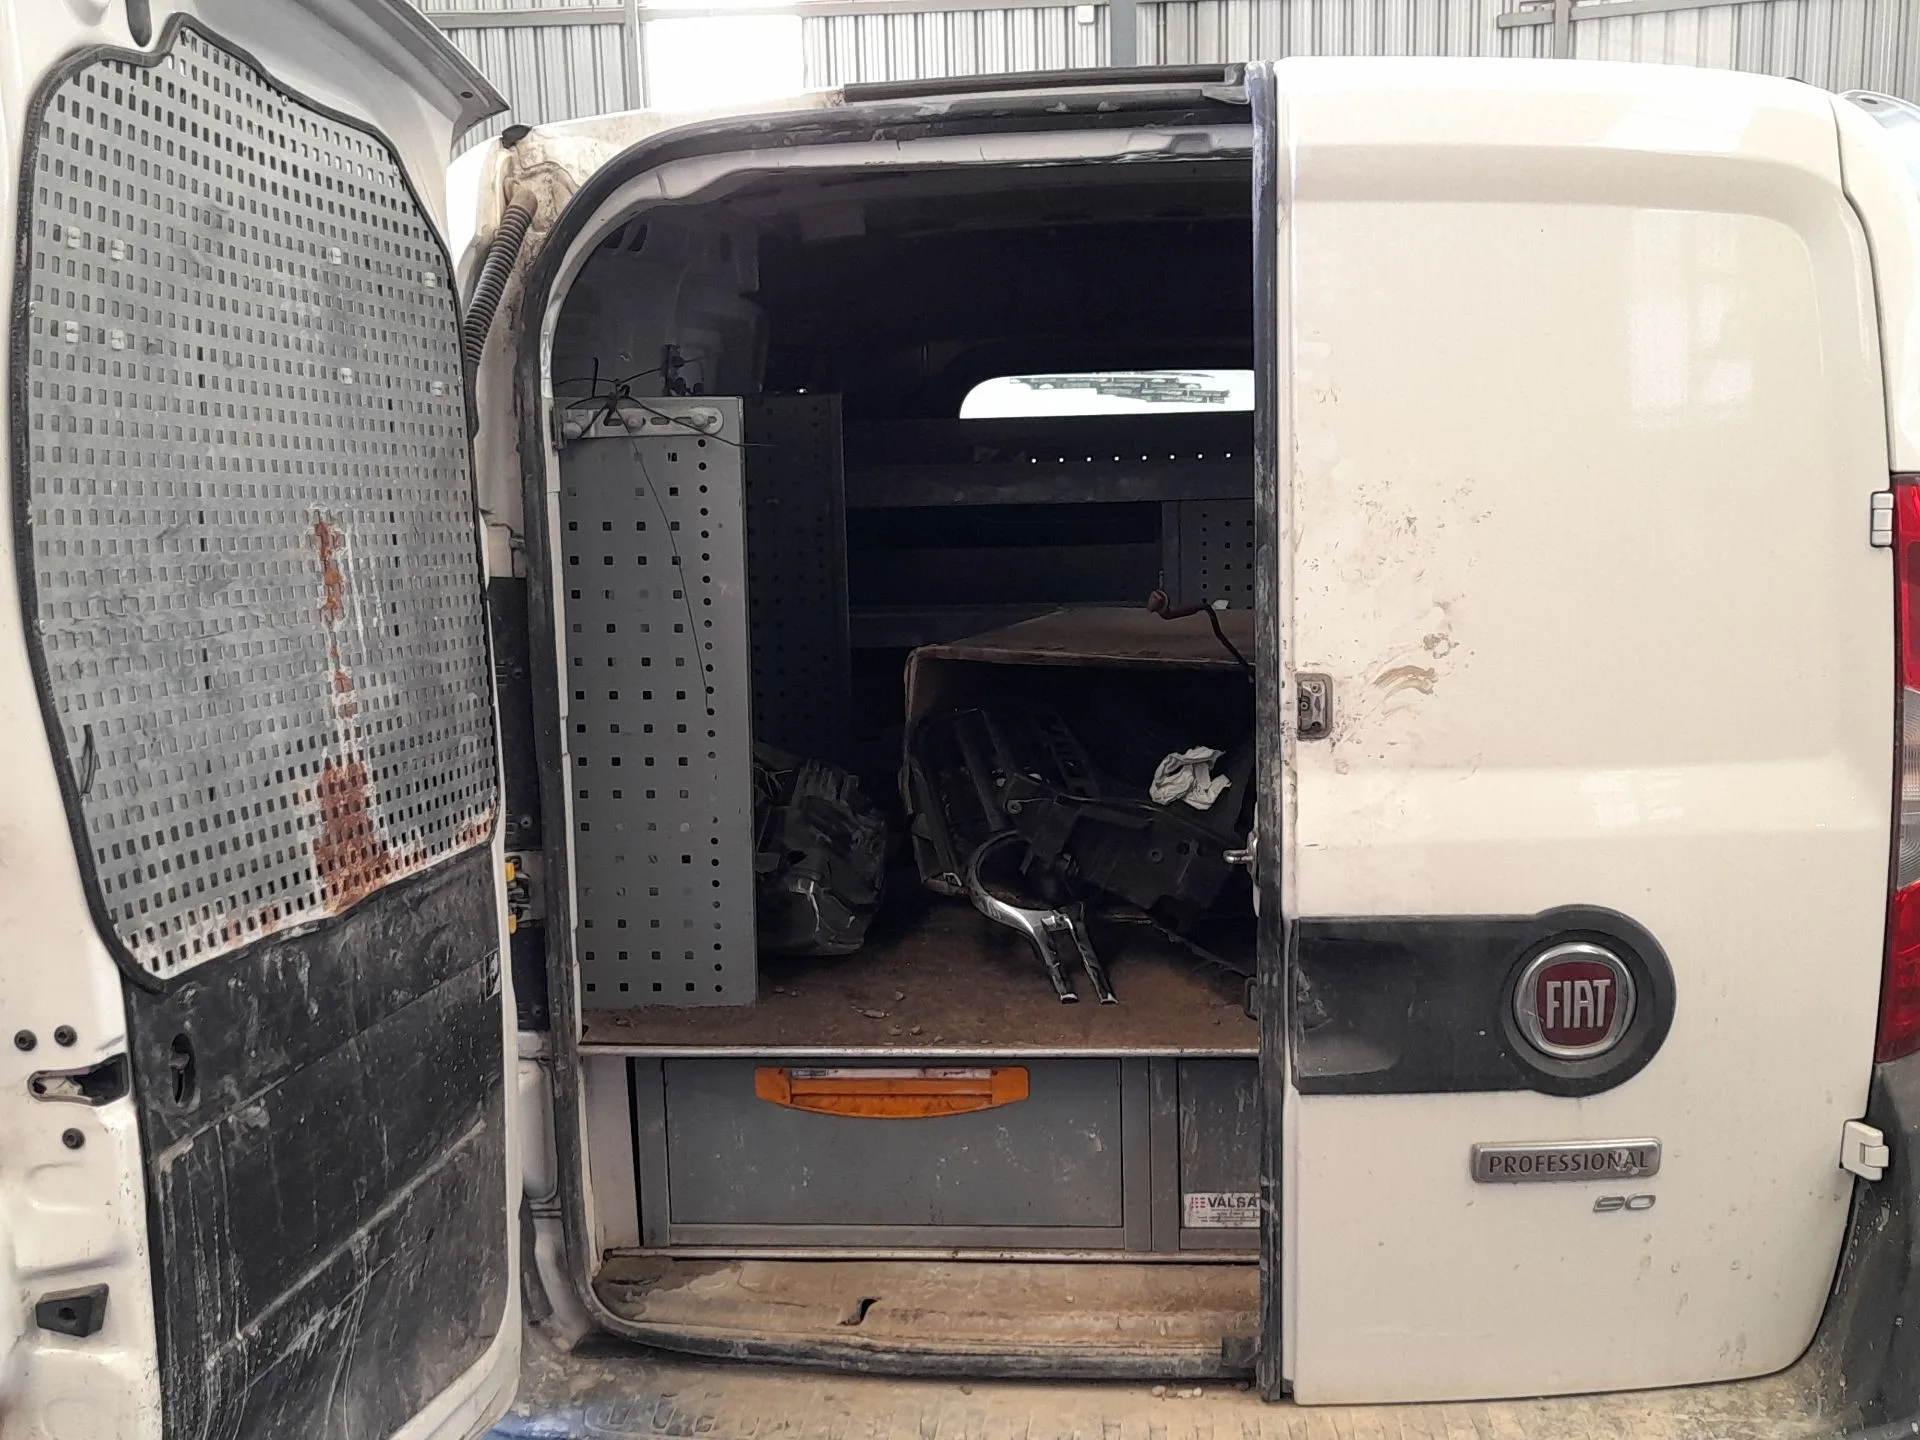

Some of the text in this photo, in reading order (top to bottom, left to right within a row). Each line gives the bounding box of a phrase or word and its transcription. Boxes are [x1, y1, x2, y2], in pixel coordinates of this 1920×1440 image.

[1546, 979, 1611, 1029] FIAT
[1488, 1151, 1649, 1174] PROFESSIONAL
[1592, 1193, 1657, 1213] 90
